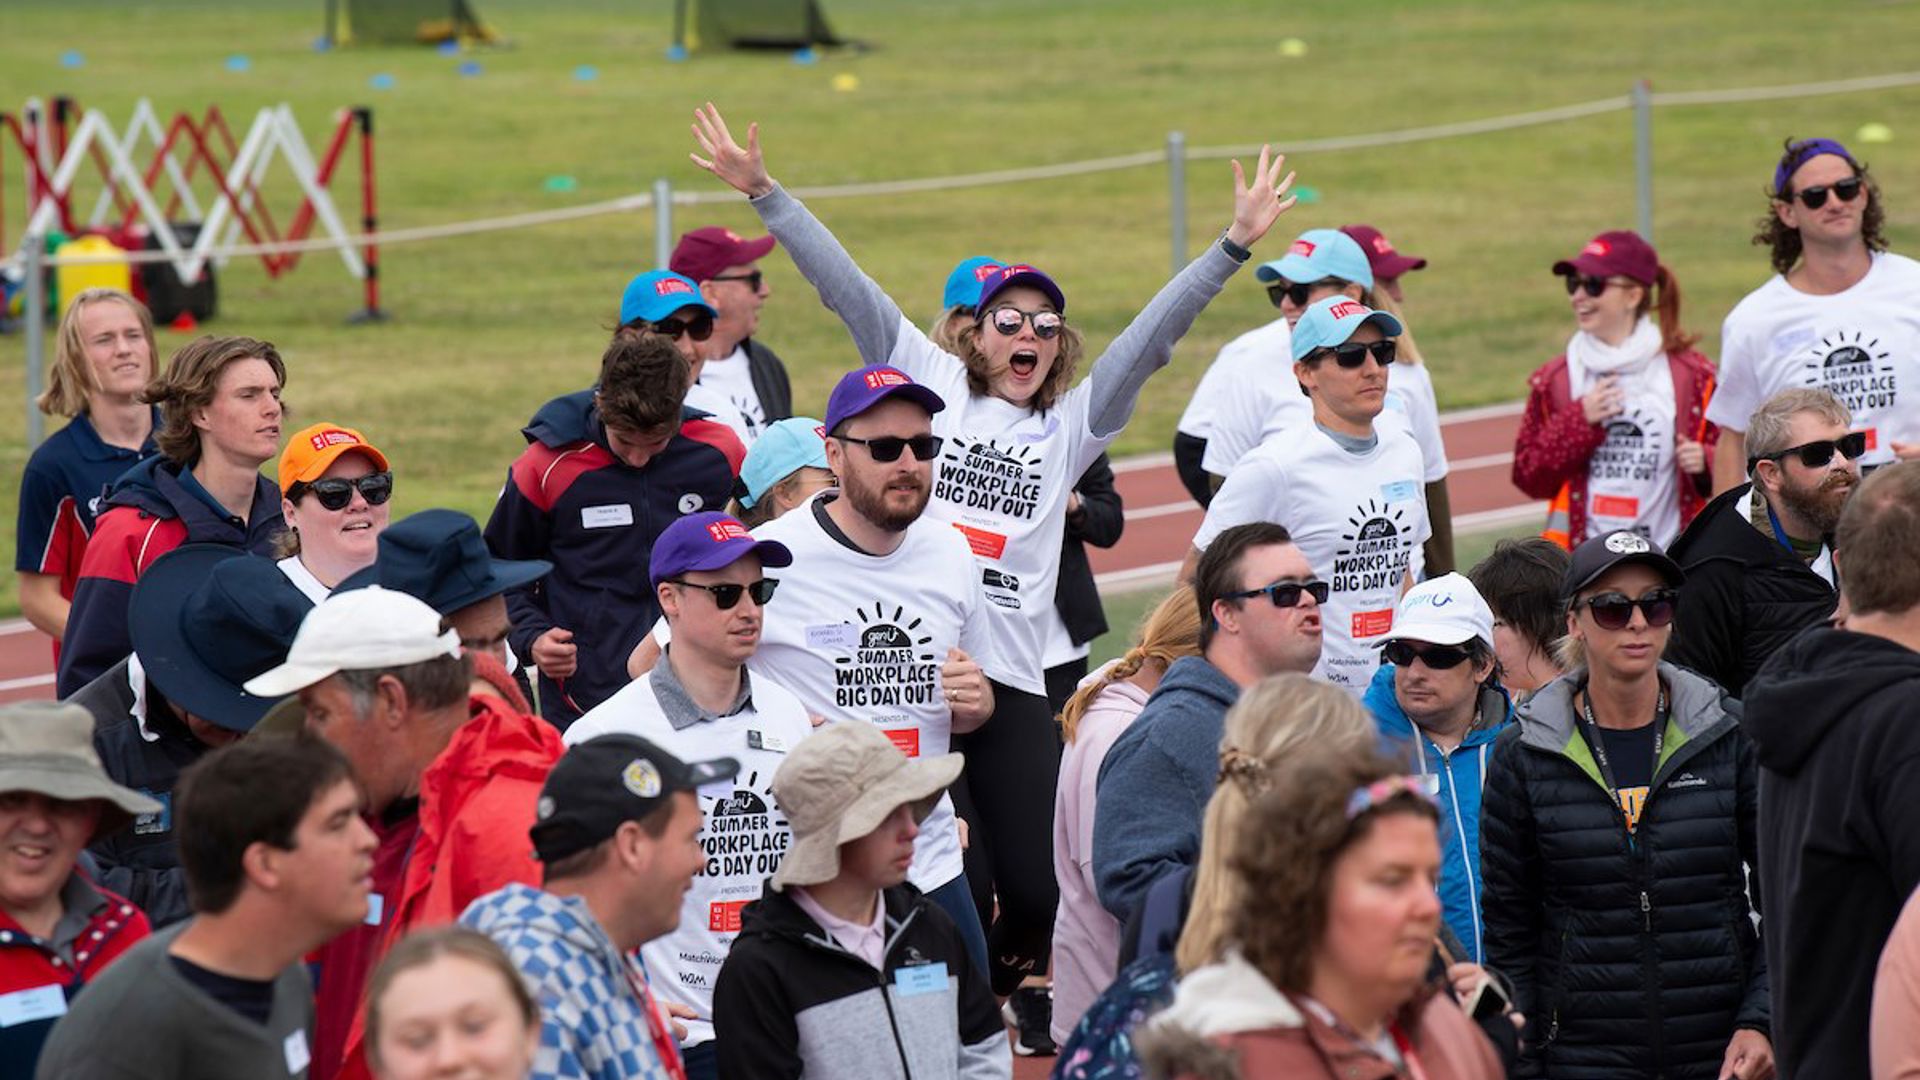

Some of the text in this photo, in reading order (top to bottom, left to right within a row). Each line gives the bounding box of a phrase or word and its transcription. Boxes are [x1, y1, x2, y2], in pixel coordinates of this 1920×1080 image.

[1823, 363, 1874, 381] SUMMER
[1867, 392, 1897, 408] OUT
[964, 454, 1024, 480] SUMMER
[940, 462, 1041, 501] WORKPLACE
[935, 481, 965, 504] BIG
[967, 489, 1001, 512] DAY
[1002, 498, 1037, 520] OUT
[1355, 537, 1399, 555] SUMMER
[1334, 550, 1411, 574] WORKPLACE
[1333, 574, 1360, 592] BIG
[1363, 571, 1387, 590] DAY
[857, 649, 915, 664] SUMMER
[835, 664, 937, 686] WORKPLACE
[836, 683, 936, 707] BIG DAY OUT
[711, 815, 770, 833] SUMMER
[724, 854, 754, 877] DAY
